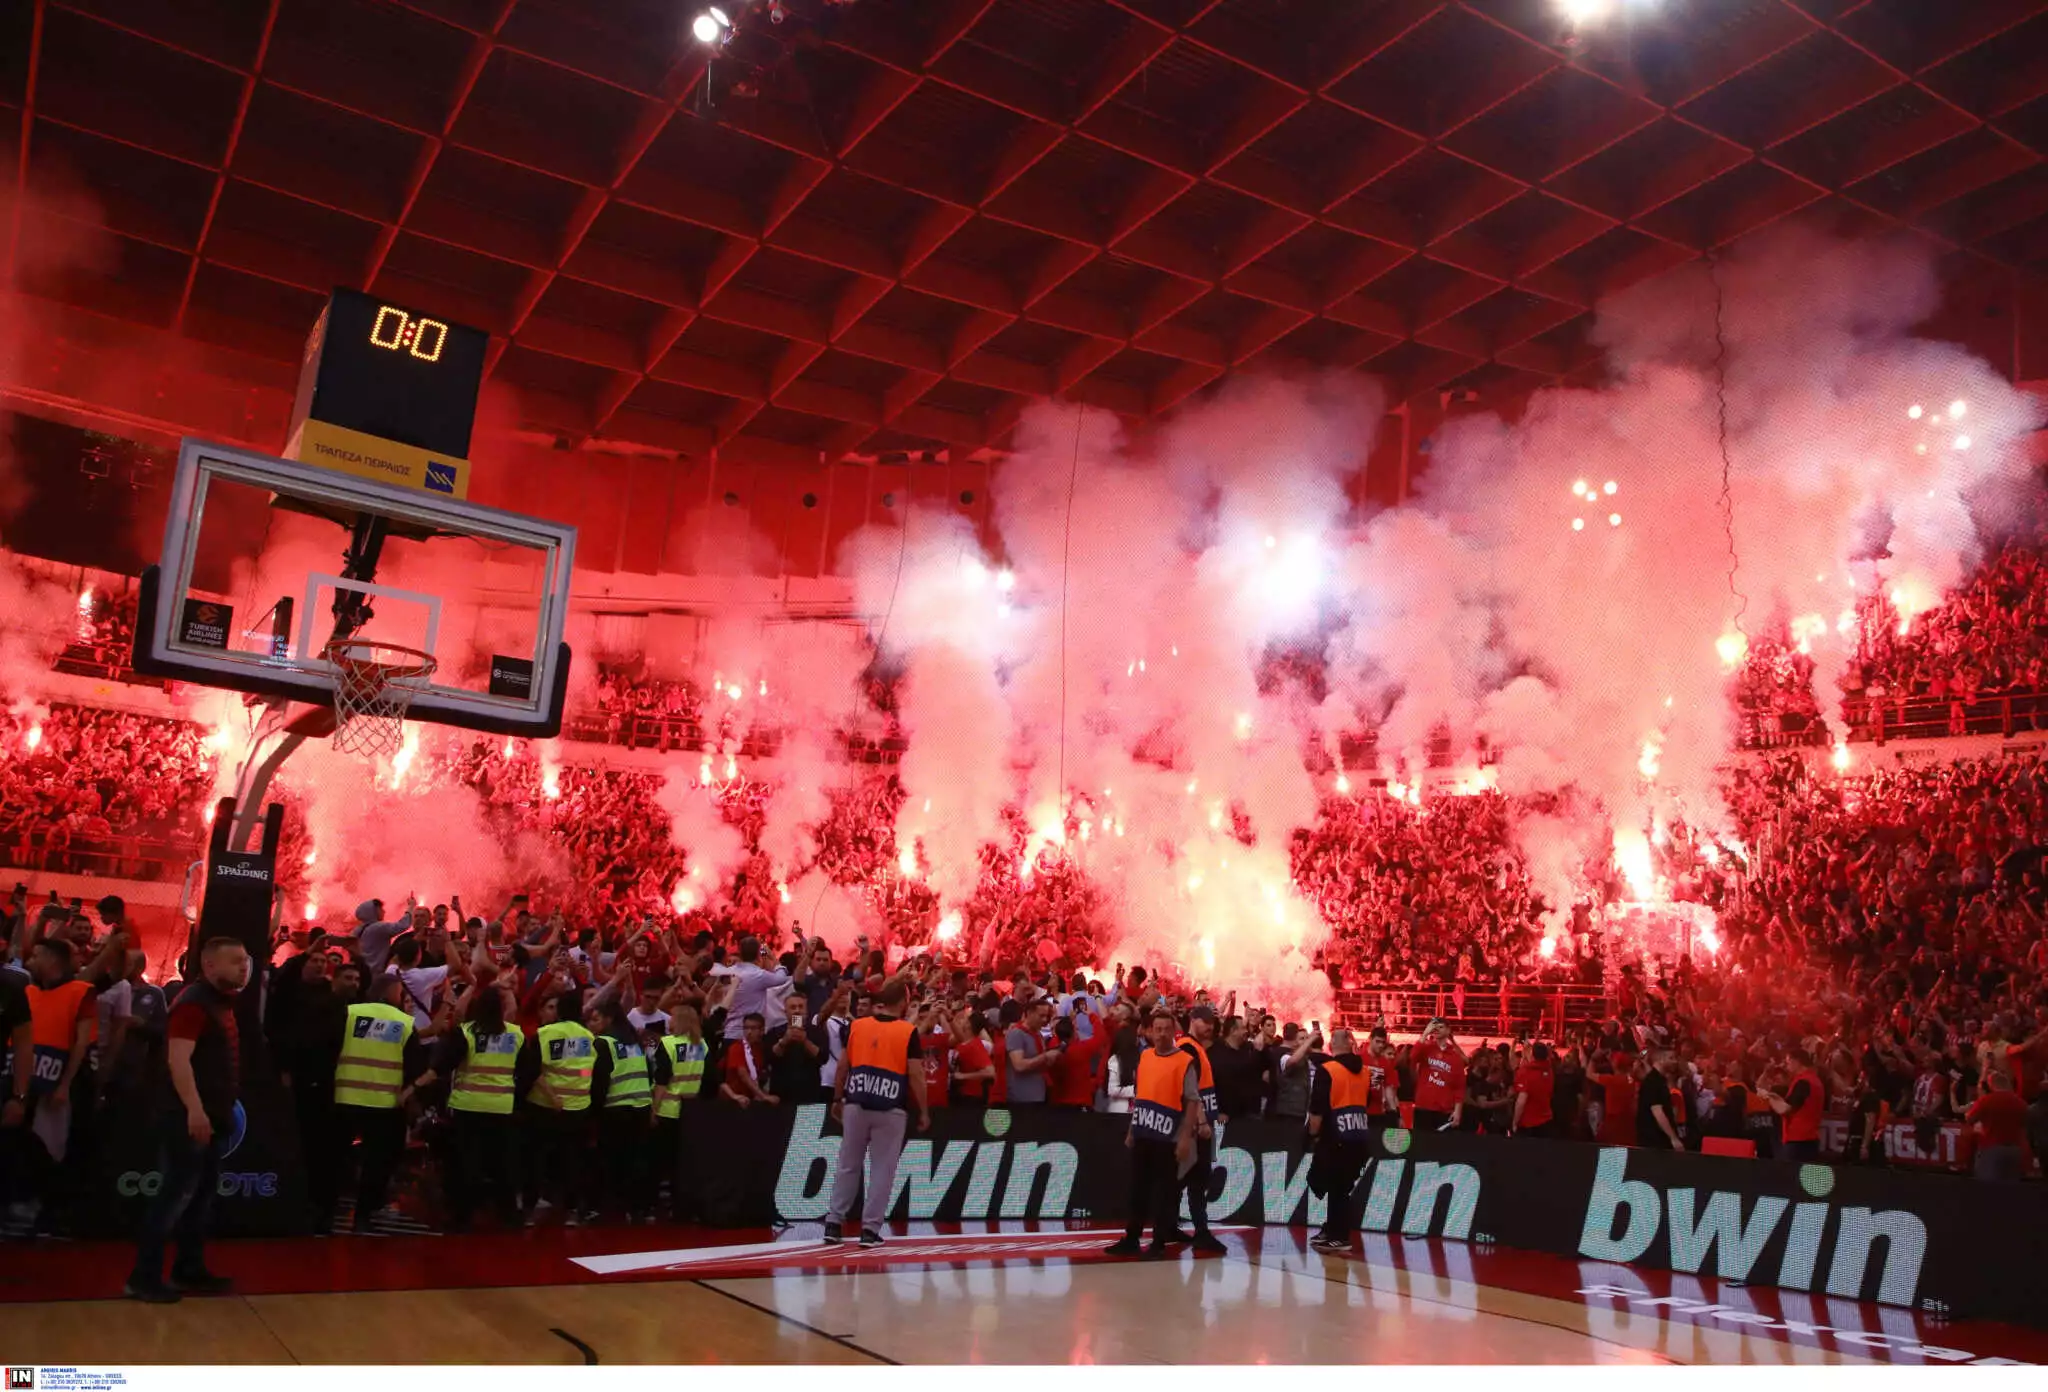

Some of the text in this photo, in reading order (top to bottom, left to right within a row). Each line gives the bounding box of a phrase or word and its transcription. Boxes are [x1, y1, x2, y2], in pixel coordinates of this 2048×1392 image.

[370, 306, 448, 362] 0:0
[188, 622, 224, 633] TURKISH
[216, 865, 269, 880] SPALDING
[774, 1103, 1079, 1220] bwin
[117, 1170, 278, 1197] COOTE
[1577, 1146, 1927, 1306] bwin
